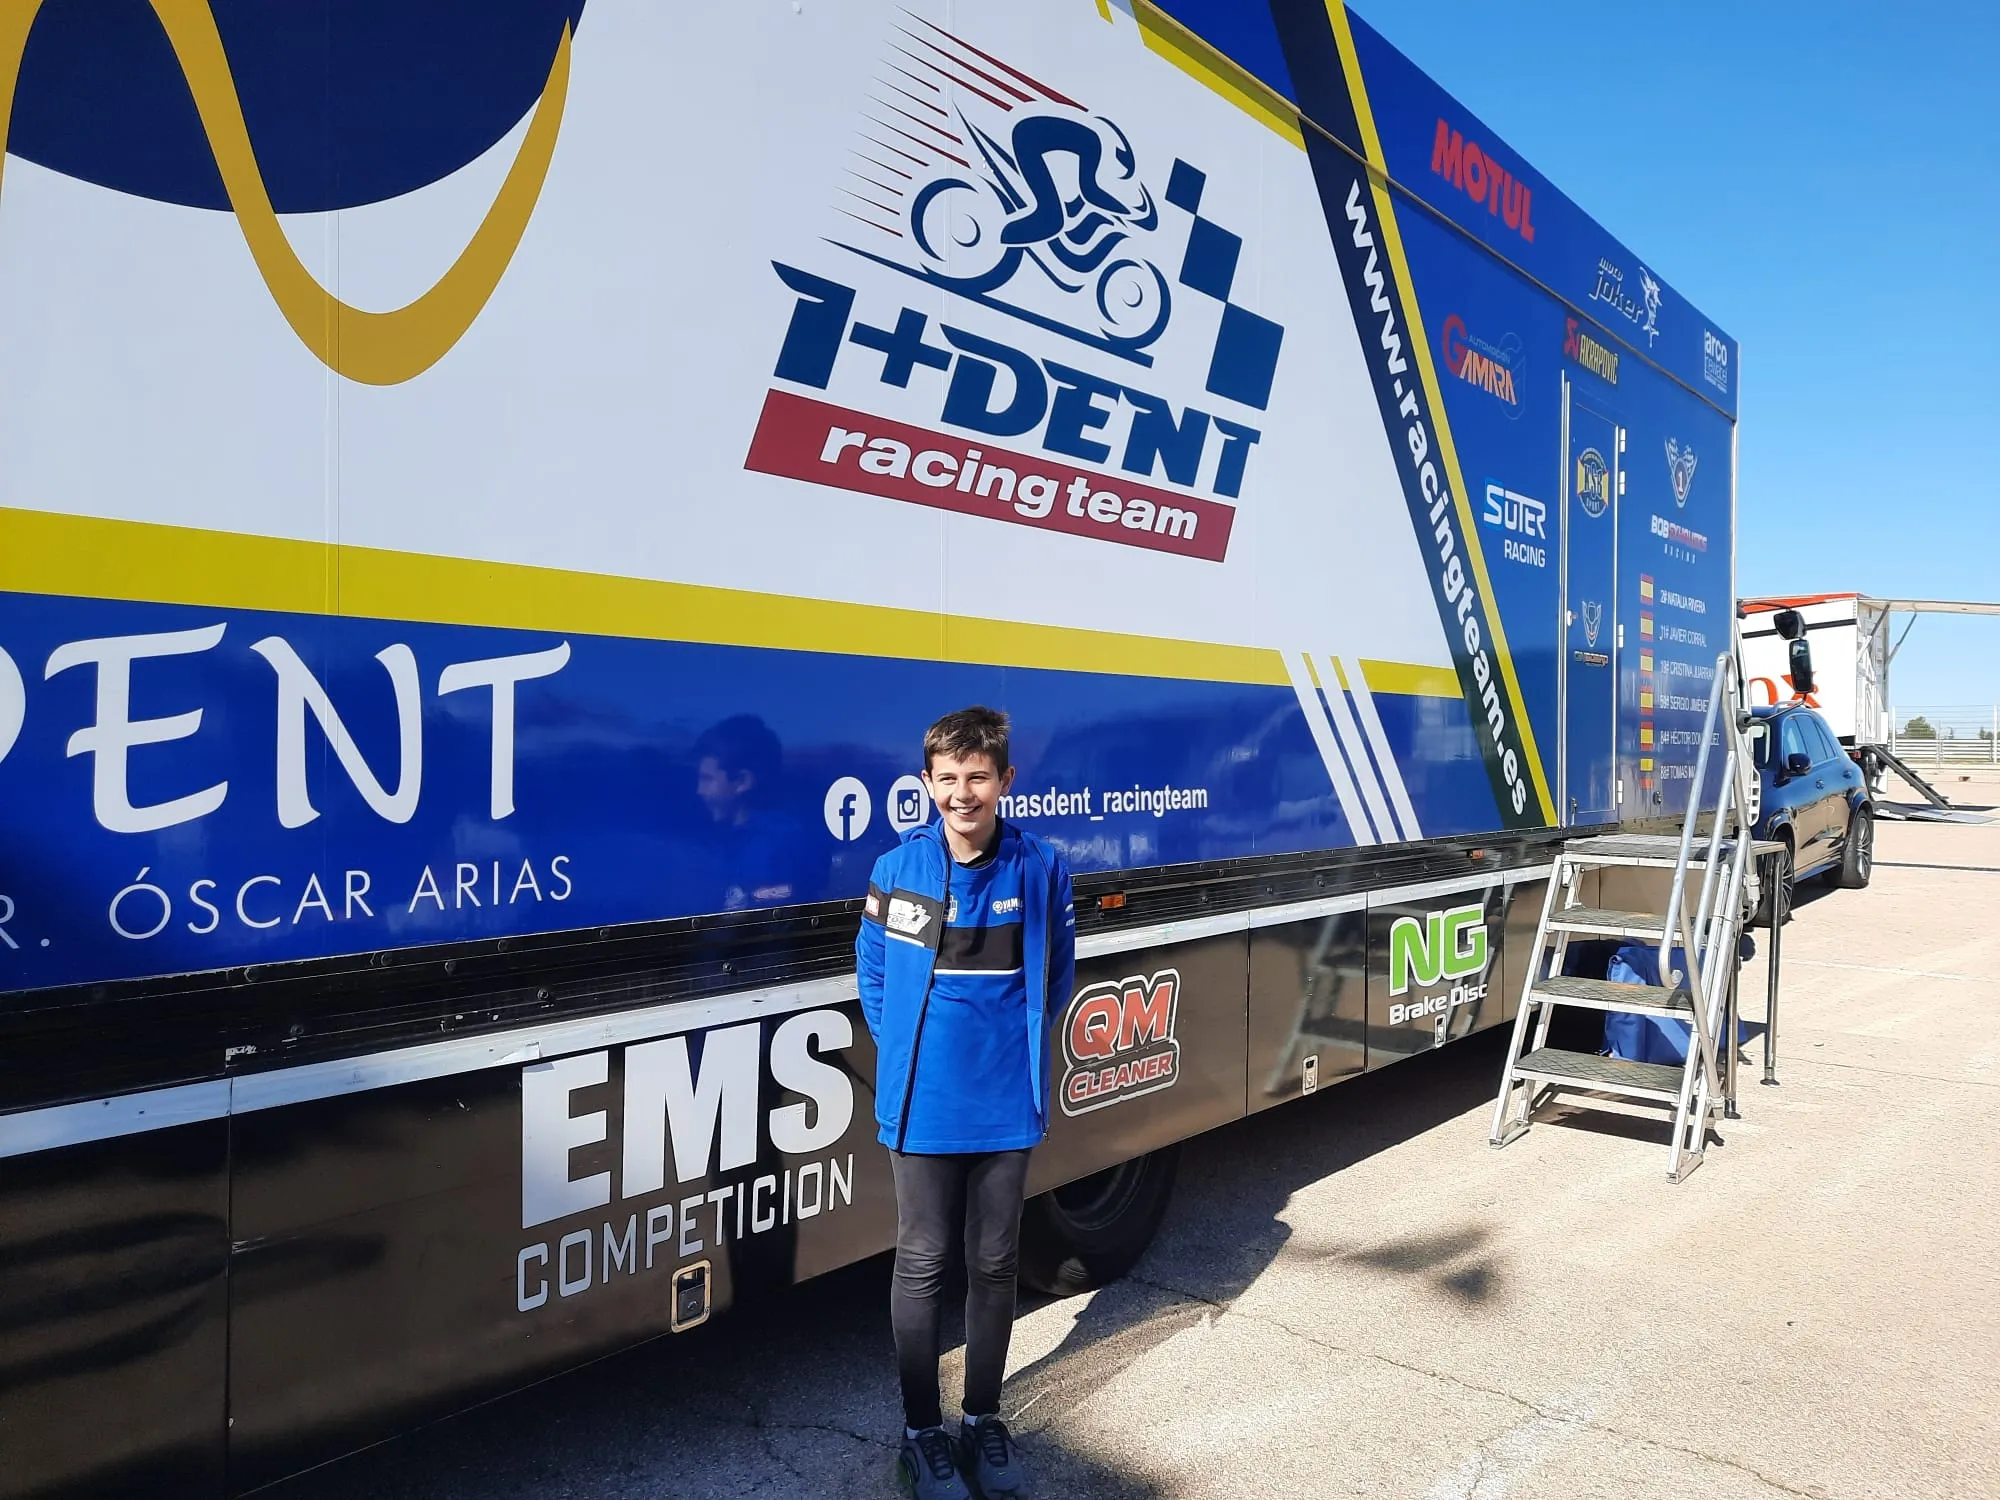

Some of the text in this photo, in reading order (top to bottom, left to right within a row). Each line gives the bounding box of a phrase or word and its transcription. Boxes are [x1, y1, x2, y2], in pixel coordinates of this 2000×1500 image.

[1431, 117, 1535, 243] MOTUL
[1705, 331, 1727, 367] arco
[819, 425, 1199, 541] racing team
[1346, 178, 1528, 816] www.racingteam.es
[1504, 538, 1546, 568] RACING
[0, 622, 571, 833] ENT
[109, 866, 374, 940] ÓSCAR
[408, 855, 573, 914] ARIAS
[1390, 903, 1487, 997] NG
[1070, 982, 1173, 1060] QM
[1390, 983, 1488, 1025] Brake Disc
[522, 1009, 853, 1229] EMS
[1068, 1052, 1174, 1103] CLEANER
[517, 1153, 853, 1312] COMPETICION
